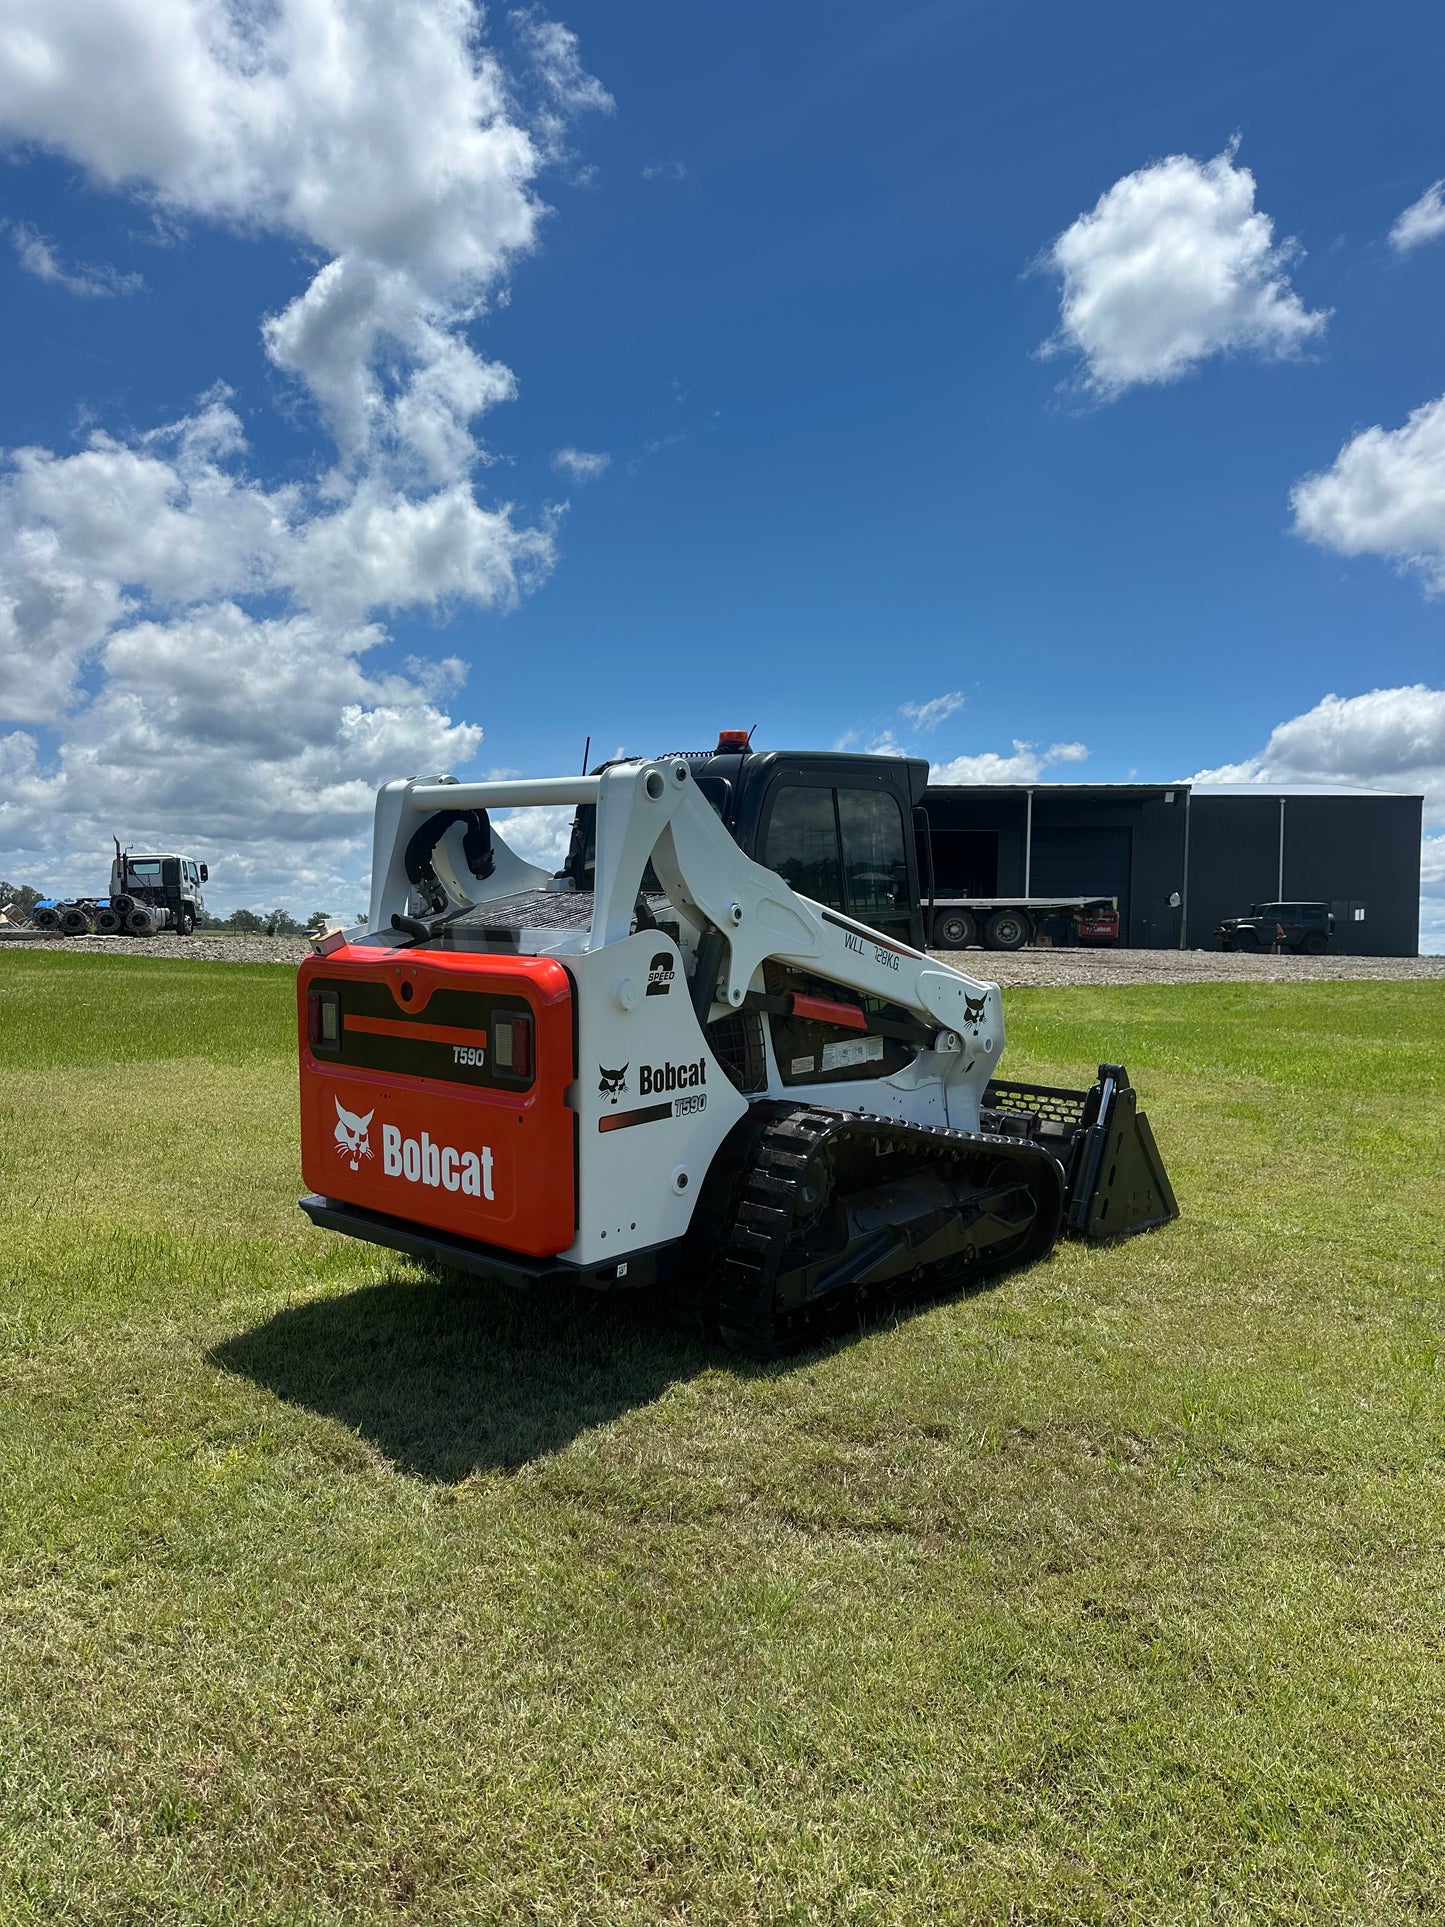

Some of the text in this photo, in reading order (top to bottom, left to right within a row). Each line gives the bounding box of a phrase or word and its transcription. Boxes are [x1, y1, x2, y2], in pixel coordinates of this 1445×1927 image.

[646, 952, 674, 996] 2
[648, 971, 675, 982] SPEED
[453, 1046, 485, 1067] T590
[639, 1057, 707, 1096] Bobcat
[674, 1093, 707, 1118] T590
[382, 1123, 495, 1201] Bobcat
